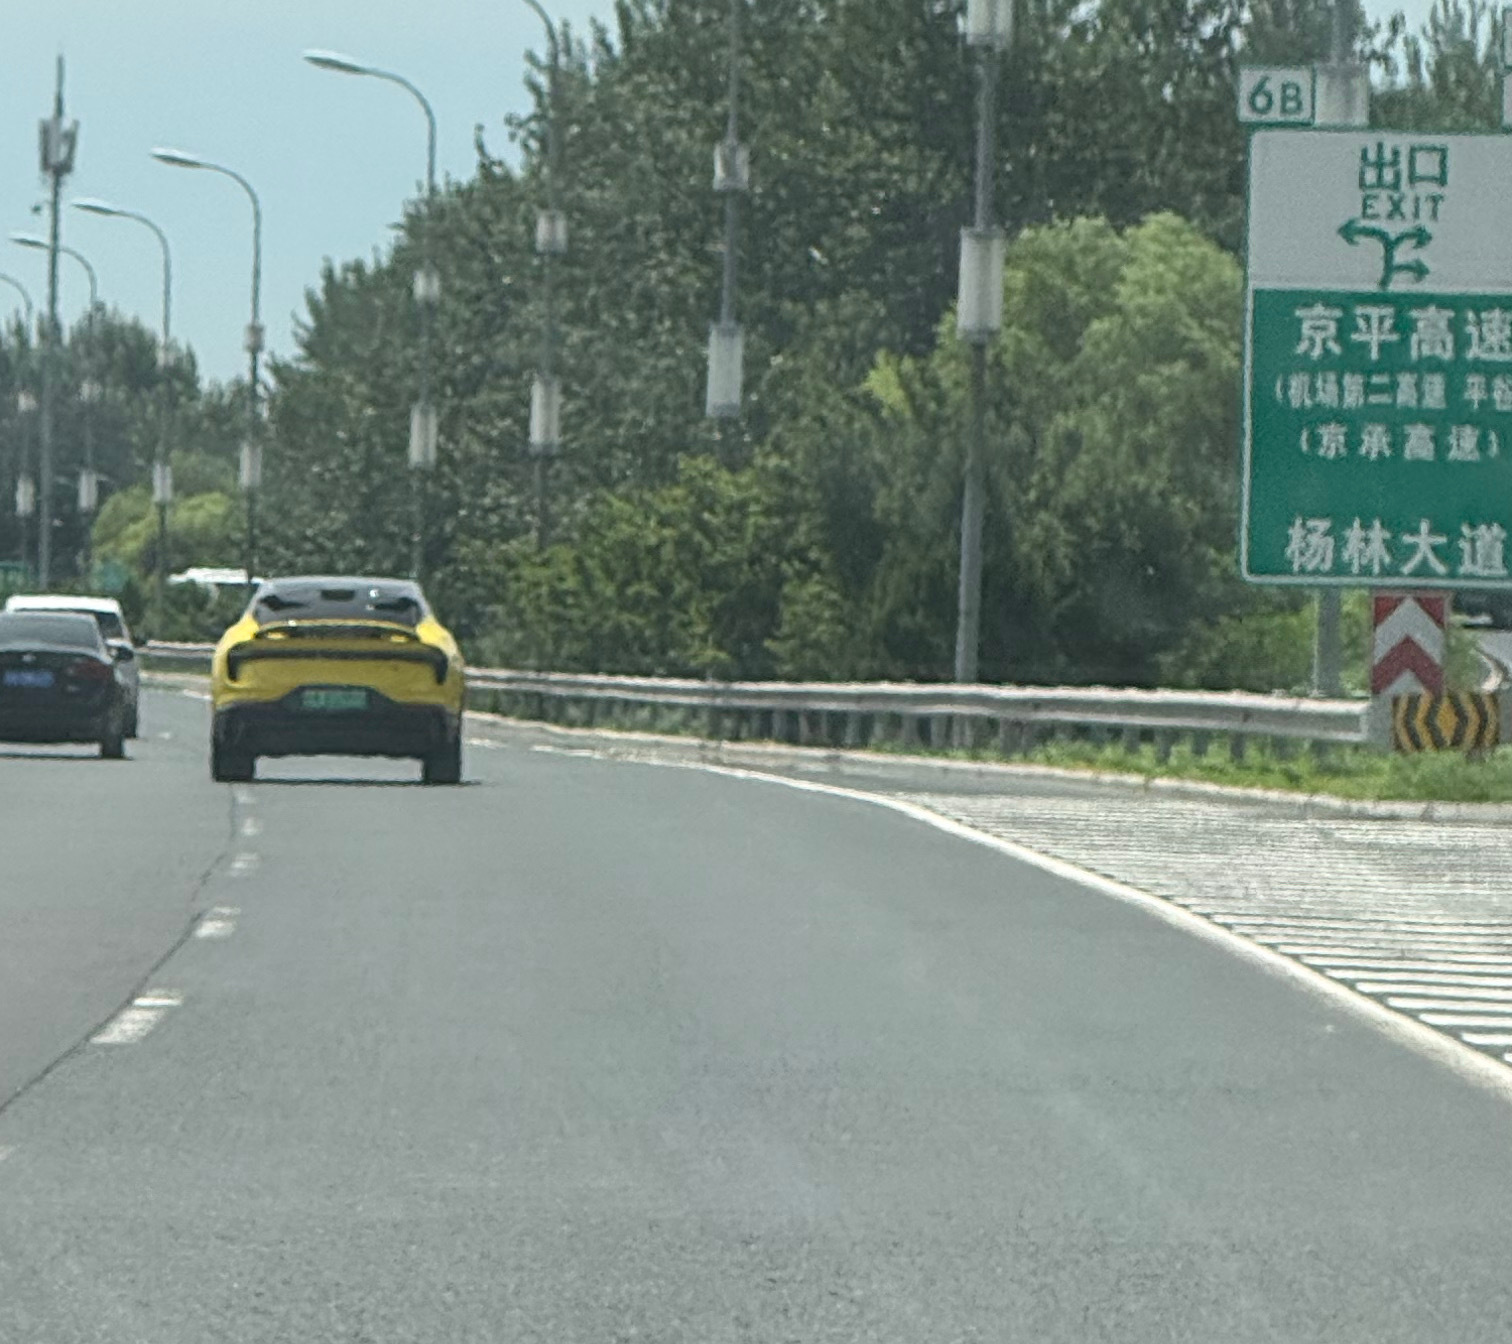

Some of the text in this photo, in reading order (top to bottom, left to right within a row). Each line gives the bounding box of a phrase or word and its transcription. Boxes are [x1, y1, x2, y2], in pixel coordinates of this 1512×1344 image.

[1248, 75, 1303, 115] 6B
[1358, 142, 1448, 190] 出口
[1361, 193, 1445, 222] EXIT
[1294, 302, 1512, 361] 京平高速
[1285, 515, 1509, 576] 杨林大道
